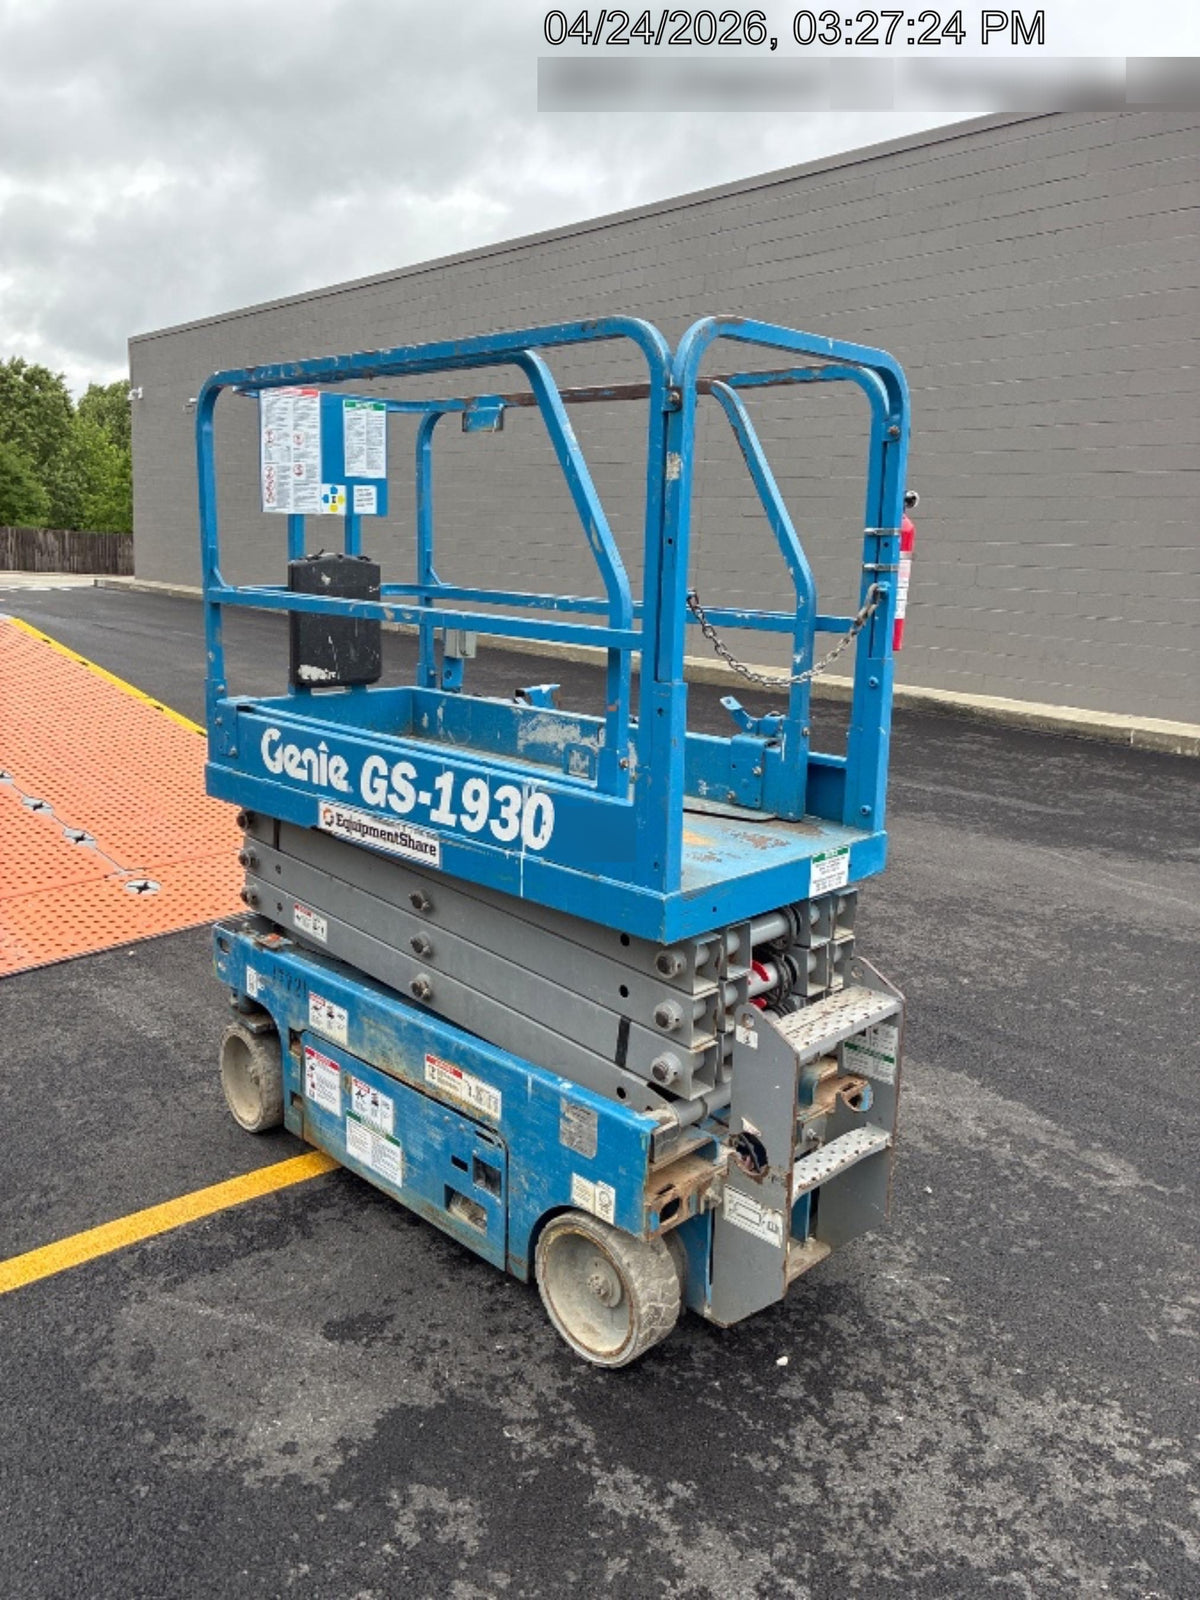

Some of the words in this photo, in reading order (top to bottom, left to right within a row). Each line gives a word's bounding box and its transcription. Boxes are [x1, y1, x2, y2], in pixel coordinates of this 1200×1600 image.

[261, 728, 349, 792] Genie
[361, 756, 555, 850] GS-1930
[335, 812, 437, 857] EquipmentShare
